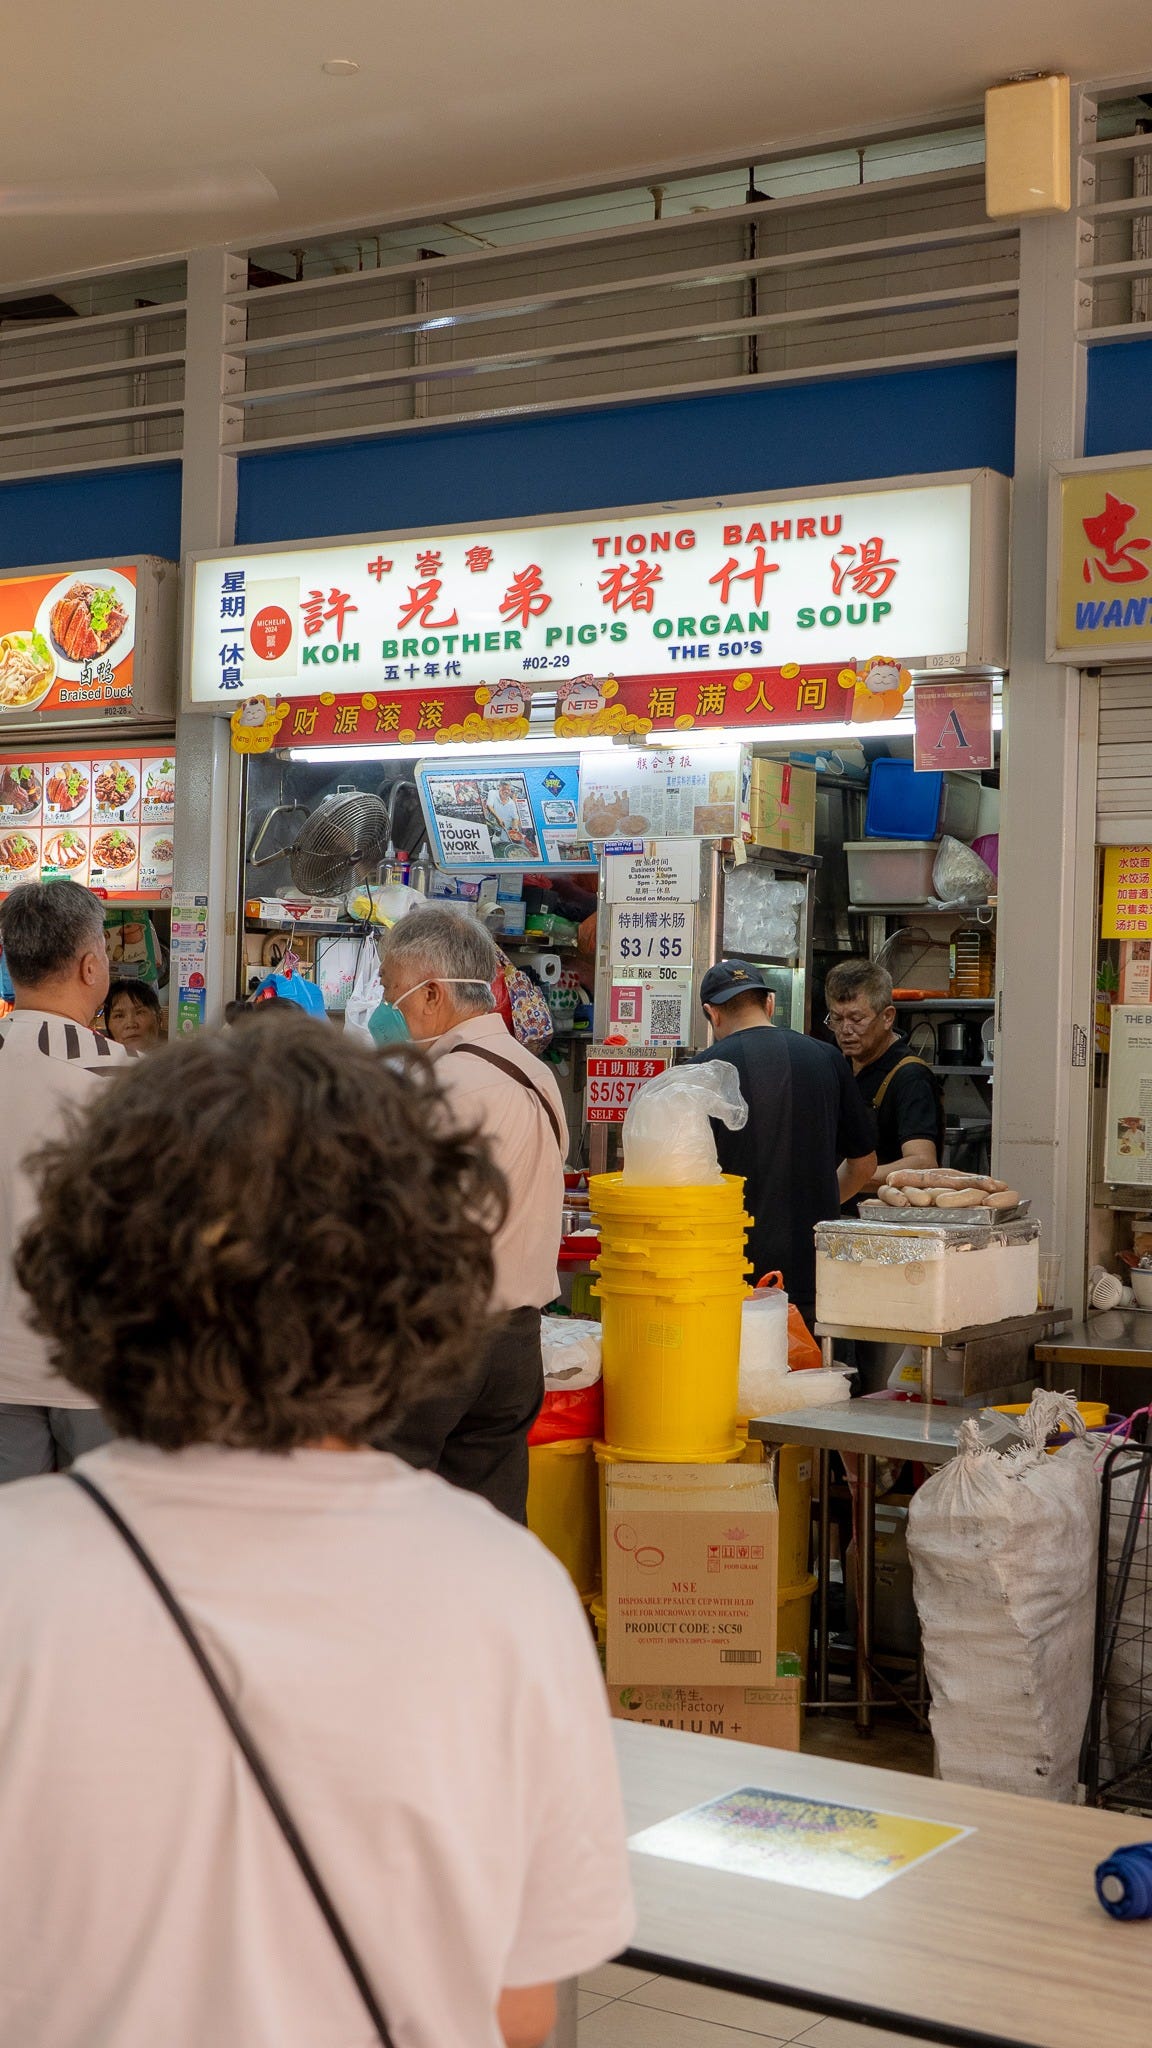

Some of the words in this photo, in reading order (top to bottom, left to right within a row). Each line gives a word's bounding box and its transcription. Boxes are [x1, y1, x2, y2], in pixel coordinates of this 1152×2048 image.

[592, 529, 696, 557] TIONG
[723, 514, 842, 546] BAHRU
[257, 618, 286, 627] MICHELIN
[219, 570, 247, 690] 星期一休息
[302, 642, 360, 665] KOH
[382, 629, 523, 660] BROTHER
[652, 610, 770, 640] ORGAN
[796, 600, 892, 630] SOUP
[668, 644, 710, 661] THE
[522, 655, 571, 671] #02-29
[932, 655, 961, 667] 02-29
[80, 658, 115, 686] 卤鸭
[383, 661, 462, 681] 五十年代
[59, 687, 101, 703] Braised
[105, 685, 134, 699] Duck
[645, 679, 828, 720] 福满人间
[104, 706, 128, 716] #02-28
[490, 703, 519, 715] NETS
[568, 700, 598, 711] NETS
[290, 700, 446, 737] 财源滚滚
[933, 709, 972, 749] A
[438, 821, 445, 829] It
[445, 821, 453, 829] is
[440, 829, 481, 839] TOUGH
[444, 841, 480, 851] WORK
[1118, 857, 1151, 869] 水饺面
[1118, 873, 1150, 884] 水饺汤
[1117, 888, 1152, 900] 加普通
[618, 912, 686, 929] 特制糯米肠
[1115, 919, 1148, 931] 汤打包
[620, 937, 642, 959] $3
[647, 937, 654, 957] /
[660, 937, 683, 959] $5
[638, 968, 652, 978] Rice
[659, 968, 678, 980] 50c
[1124, 1014, 1143, 1024] THE
[1145, 1014, 1152, 1024] B
[595, 1060, 656, 1076] 自助服务
[590, 1109, 614, 1120] SELF
[672, 1582, 697, 1593] MSE
[618, 1596, 661, 1605] DISPOSABLE
[663, 1597, 672, 1605] PP
[672, 1597, 696, 1606] SAUCE
[698, 1598, 713, 1606] CUP
[621, 1608, 637, 1617] SAFE
[640, 1608, 653, 1617] FOR
[655, 1609, 696, 1617] MICROWAVE
[698, 1609, 717, 1617] OVEN
[625, 1622, 677, 1633] PRODUCT
[679, 1622, 710, 1634] CODE
[718, 1623, 743, 1634] SC50
[644, 1699, 725, 1715] GreenFactory
